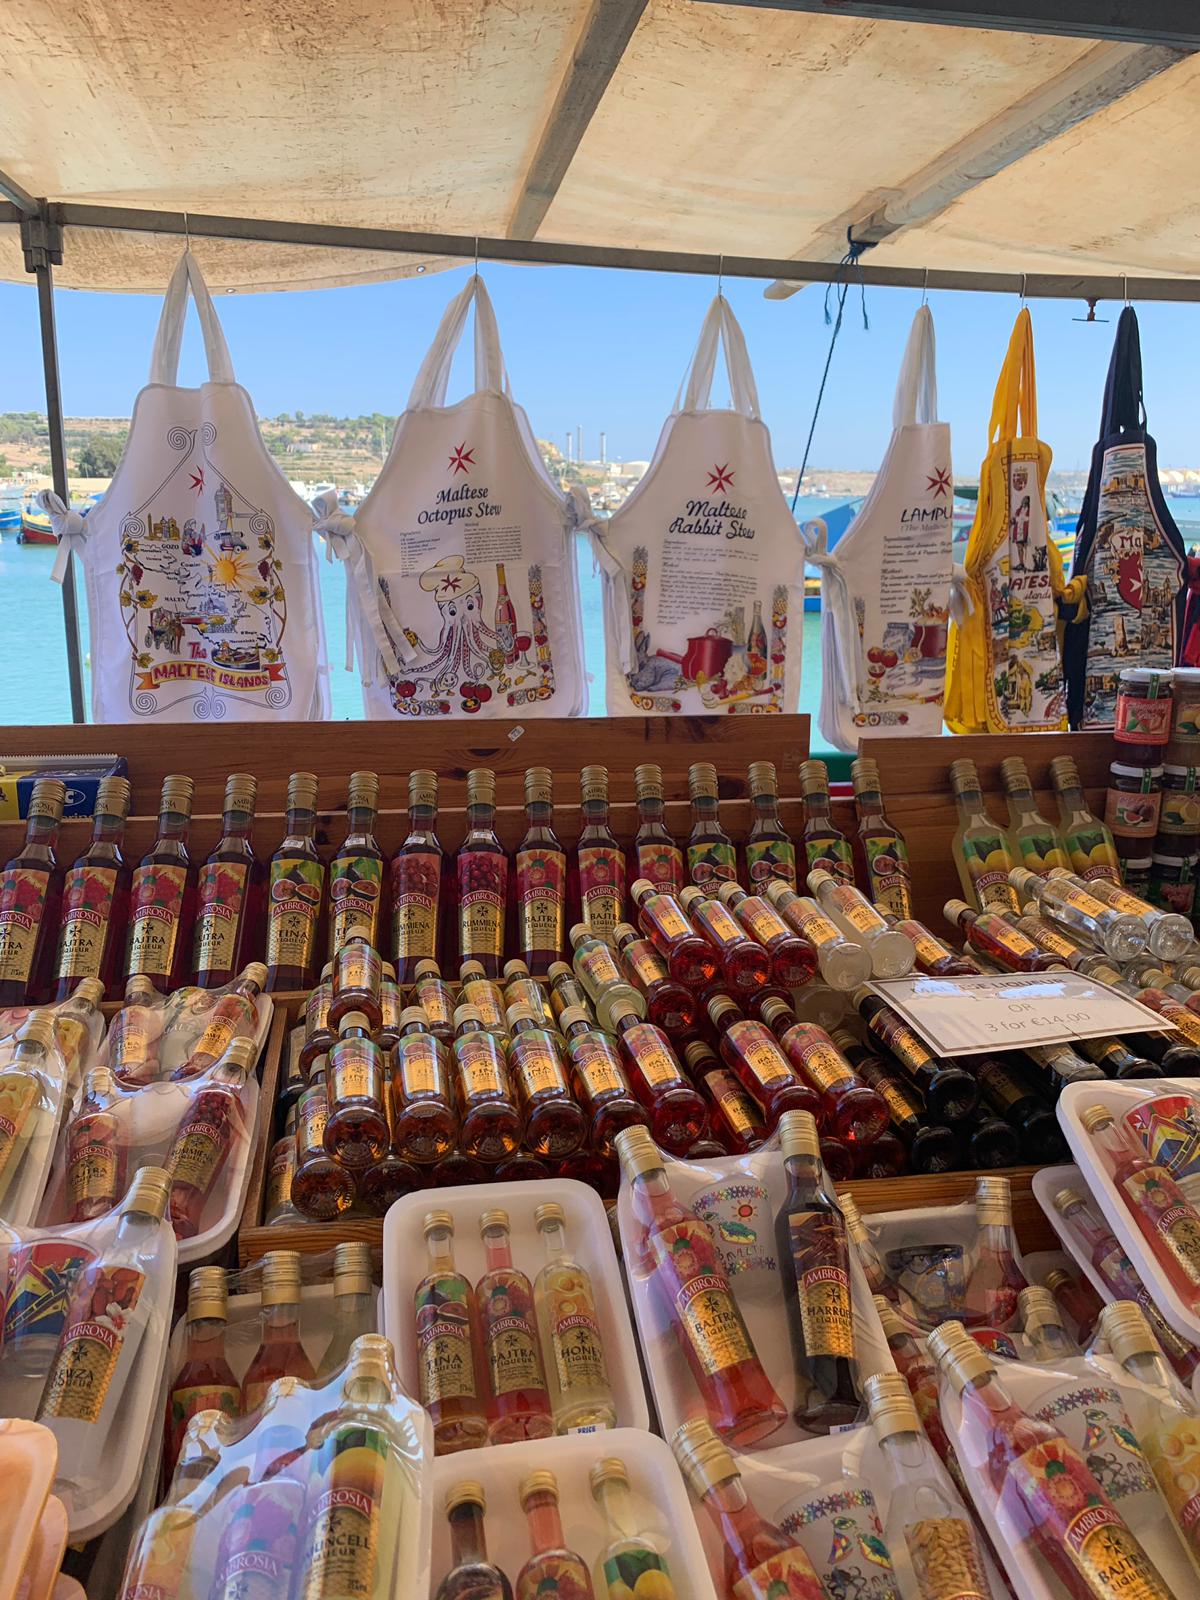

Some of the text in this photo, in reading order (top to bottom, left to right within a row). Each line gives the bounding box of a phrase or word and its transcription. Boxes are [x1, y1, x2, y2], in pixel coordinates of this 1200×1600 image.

[436, 484, 489, 505] Maltese
[417, 502, 502, 525] Octopus Stew
[686, 500, 748, 519] Maltese
[669, 517, 756, 540] Rabbit Stew
[188, 642, 207, 660] The
[153, 664, 270, 689] MALTESE ISLANDS
[273, 901, 315, 919] AMBROSIA
[333, 899, 374, 917] AMBROSIA
[0, 913, 31, 930] BROSIA
[1007, 1003, 1035, 1015] OR
[985, 1011, 1092, 1034] 3 for €14.00
[680, 1277, 730, 1307] AMBROSIA
[489, 1318, 533, 1337] AMBROSIA
[557, 1317, 600, 1333] AMBROSIA
[694, 1311, 739, 1334] BAJTRA
[422, 1323, 465, 1344] AMBROSIA
[426, 1354, 463, 1370] TINA
[490, 1349, 537, 1367] BAJTRA
[1068, 1508, 1126, 1552] AMBROSIA
